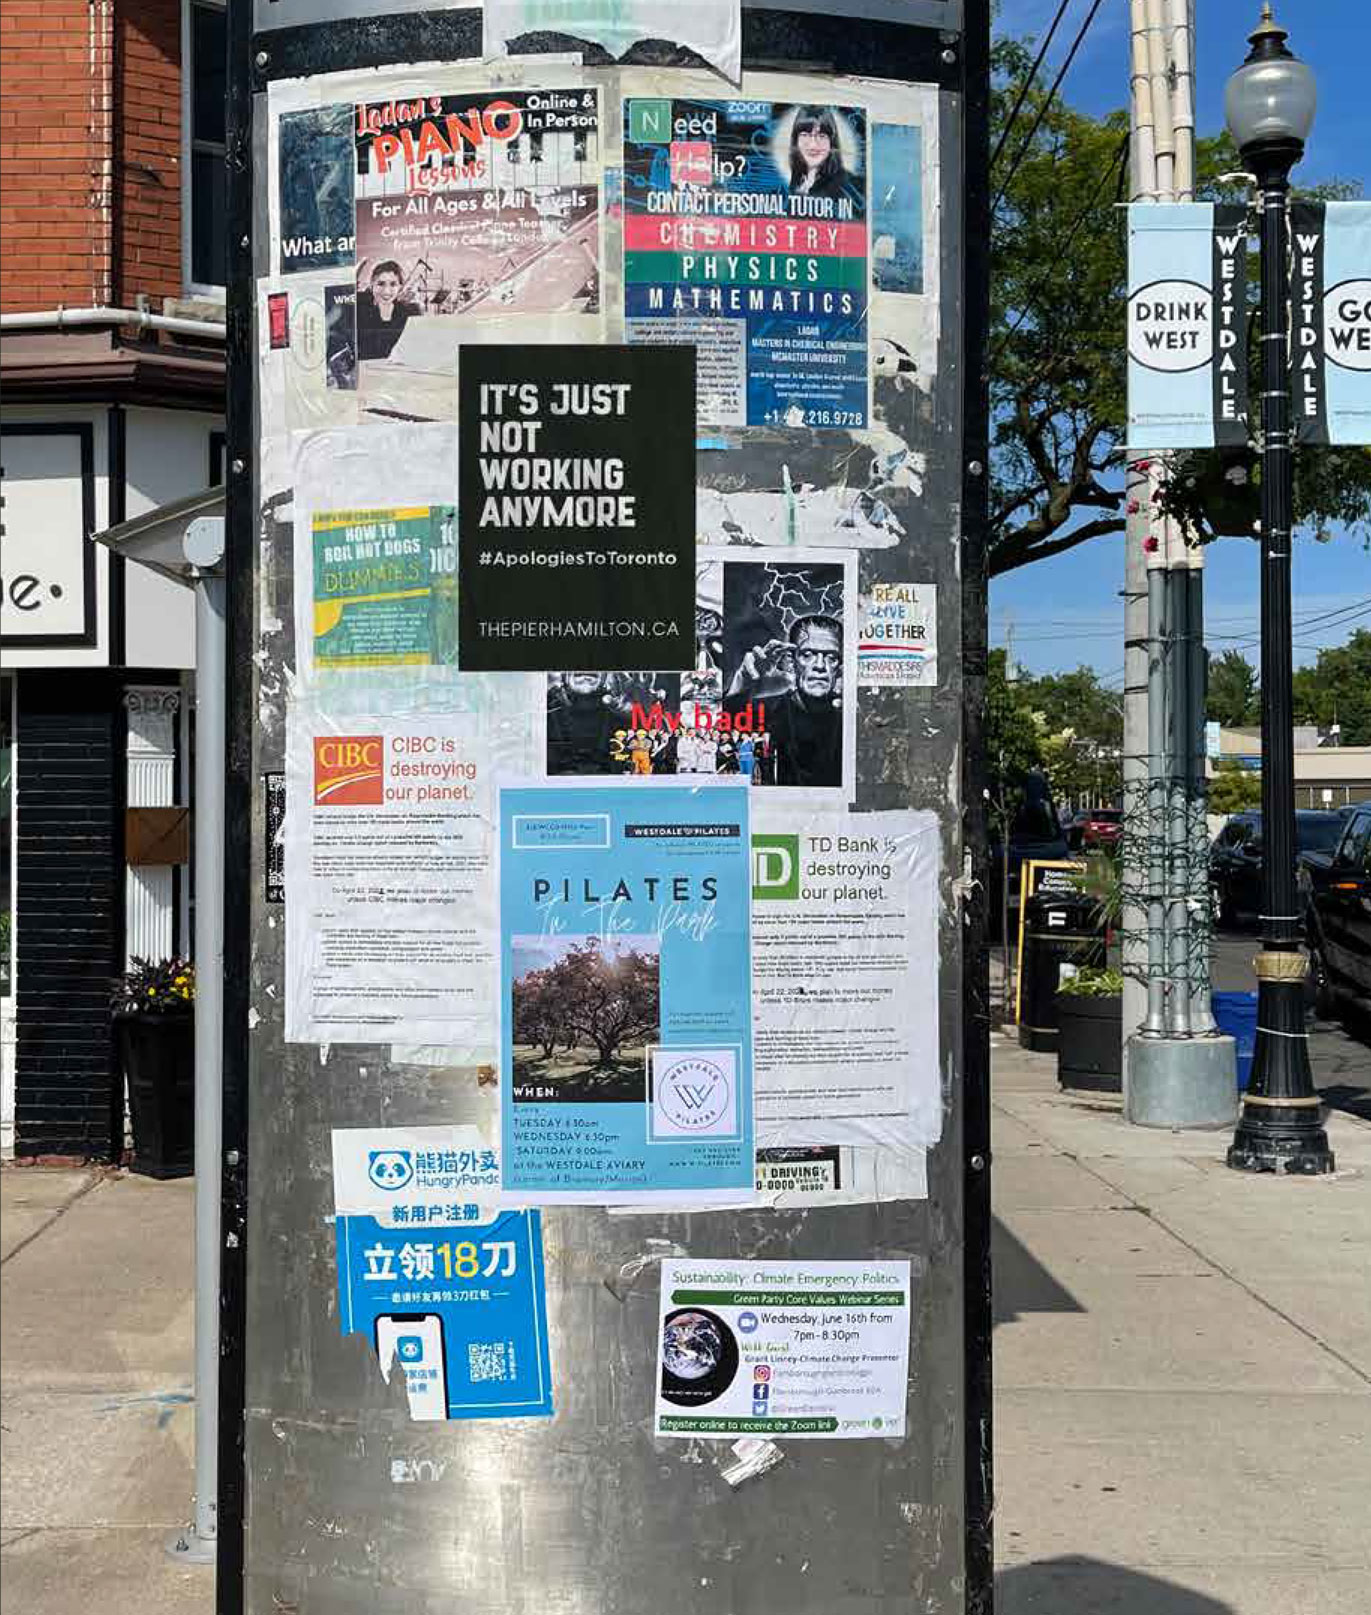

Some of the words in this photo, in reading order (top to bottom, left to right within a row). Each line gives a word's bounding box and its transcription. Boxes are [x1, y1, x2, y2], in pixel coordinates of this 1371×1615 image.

[527, 94, 577, 109] Online
[582, 94, 595, 108] &
[528, 116, 542, 128] In
[546, 113, 598, 128] Person
[642, 112, 718, 135] Need
[372, 99, 523, 174] PIANO
[405, 159, 486, 197] Lessons
[371, 202, 401, 218] For
[405, 198, 429, 215] All
[433, 196, 478, 216] Ages
[482, 192, 495, 209] &
[501, 190, 526, 208] All
[646, 192, 712, 213] CONTACT
[714, 193, 787, 216] PERSONAL
[788, 195, 833, 218] TUTOR
[837, 198, 853, 219] IN
[660, 221, 838, 250] CHEMISTRY
[282, 236, 332, 258] What
[682, 256, 818, 282] PHYSICS
[649, 288, 852, 315] MATHEMATICS
[1135, 301, 1208, 322] DRINK
[1216, 234, 1240, 419] WESTDALE
[1296, 233, 1320, 416] WESTDALE
[1144, 330, 1201, 350] WEST
[480, 383, 539, 415] IT'S
[550, 383, 632, 415] JUST
[480, 421, 543, 453] NOT
[479, 458, 625, 490] WORKING
[479, 496, 636, 528] ANYMORE
[345, 524, 377, 543] HOW
[379, 522, 397, 539] TO
[384, 537, 422, 557] DOGS
[478, 550, 678, 568] #ApologiesToToronto
[478, 620, 681, 638] THEPIERHAMILTON.CA
[630, 701, 683, 734] My
[694, 701, 766, 733] bad!
[391, 736, 435, 753] CIBC
[441, 737, 456, 752] is
[318, 742, 381, 768] CIBC
[390, 761, 477, 780] destroying
[385, 787, 413, 800] our
[417, 783, 474, 803] planet.
[809, 836, 833, 853] TD
[837, 836, 880, 853] Bank
[806, 861, 893, 880] destroying
[533, 876, 719, 902] PILATES
[801, 886, 829, 900] our
[833, 884, 889, 903] planet.
[513, 1086, 560, 1098] WHEN:
[513, 1118, 562, 1128] TUESDAY
[513, 1132, 581, 1141] WEDNESDAY
[516, 1146, 573, 1155] SATURDAY
[416, 1149, 500, 1174] 熊猫外卖
[546, 1160, 603, 1170] WESTDALE
[606, 1160, 646, 1170] AVIARY
[391, 1204, 480, 1222] 新用户注册
[363, 1240, 518, 1281] 立领18刀
[753, 1271, 794, 1285] Climate
[798, 1273, 858, 1288] Emergency
[862, 1272, 900, 1286] Politics
[733, 1293, 760, 1305] Green
[761, 1294, 784, 1306] Party
[786, 1294, 808, 1305] Core
[822, 1313, 843, 1326] June
[846, 1312, 868, 1324] 16th
[870, 1312, 894, 1324] from
[660, 1418, 698, 1431] Register
[699, 1419, 726, 1430] online
[727, 1419, 739, 1430] to
[740, 1420, 772, 1431] receive
[774, 1419, 789, 1431] the
[790, 1420, 817, 1431] Zoom
[817, 1419, 833, 1430] link
